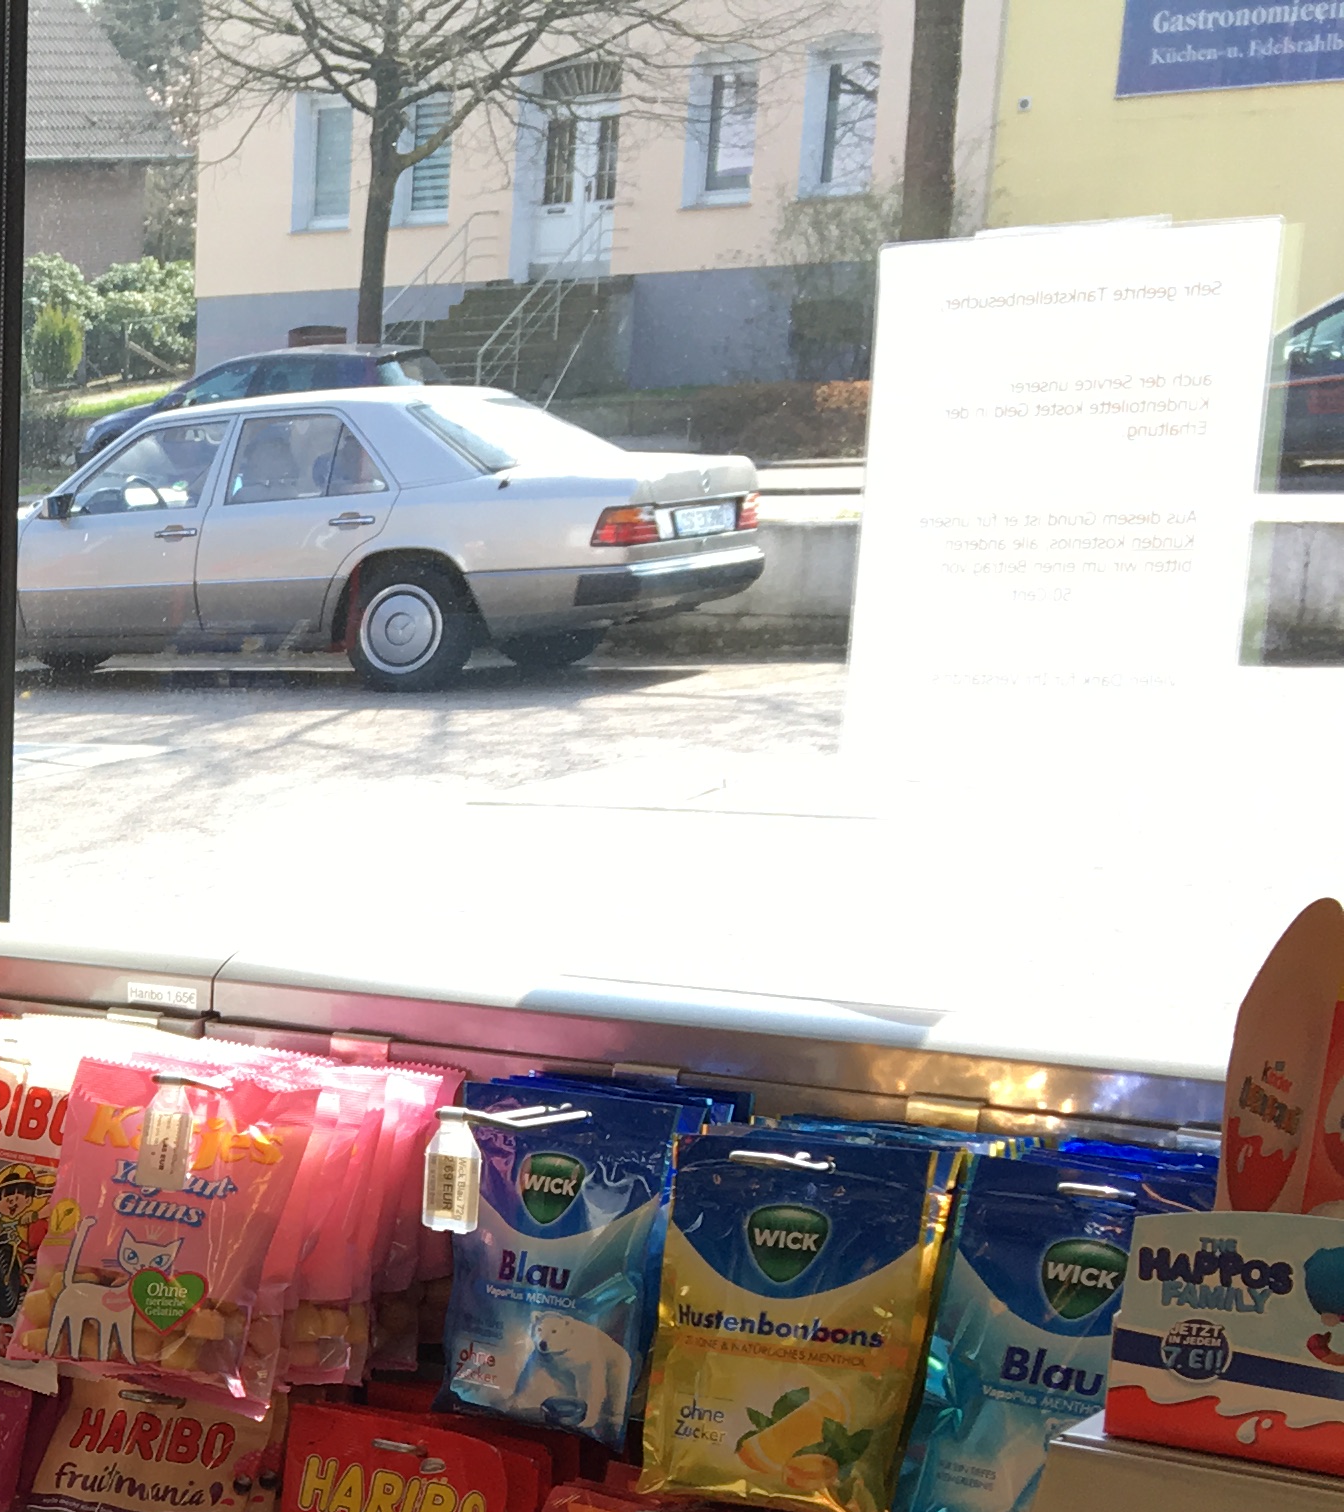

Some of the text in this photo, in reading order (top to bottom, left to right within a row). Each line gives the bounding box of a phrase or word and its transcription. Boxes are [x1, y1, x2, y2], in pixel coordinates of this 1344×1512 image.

[129, 985, 196, 1005] Haribo 1,65€
[524, 1172, 577, 1197] WICK
[113, 1193, 206, 1227] Gums
[753, 1228, 820, 1253] WICK
[498, 1249, 572, 1292] Blau
[1046, 1261, 1120, 1292] WICK
[1139, 1247, 1293, 1296] HAPPOS
[147, 1283, 187, 1300] Ohne
[526, 1292, 578, 1310] MENTHOL
[1161, 1281, 1272, 1315] FAMILY
[677, 1304, 886, 1350] Hustenbonbons
[1169, 1321, 1224, 1339] JETZT
[1181, 1335, 1222, 1349] JEDEM
[809, 1352, 867, 1368] MENTHOL
[1000, 1346, 1104, 1397] Blau
[679, 1401, 726, 1424] ohne
[70, 1405, 236, 1470] HARIBO
[674, 1418, 727, 1444] Zucker
[53, 1461, 206, 1507] fruitmania
